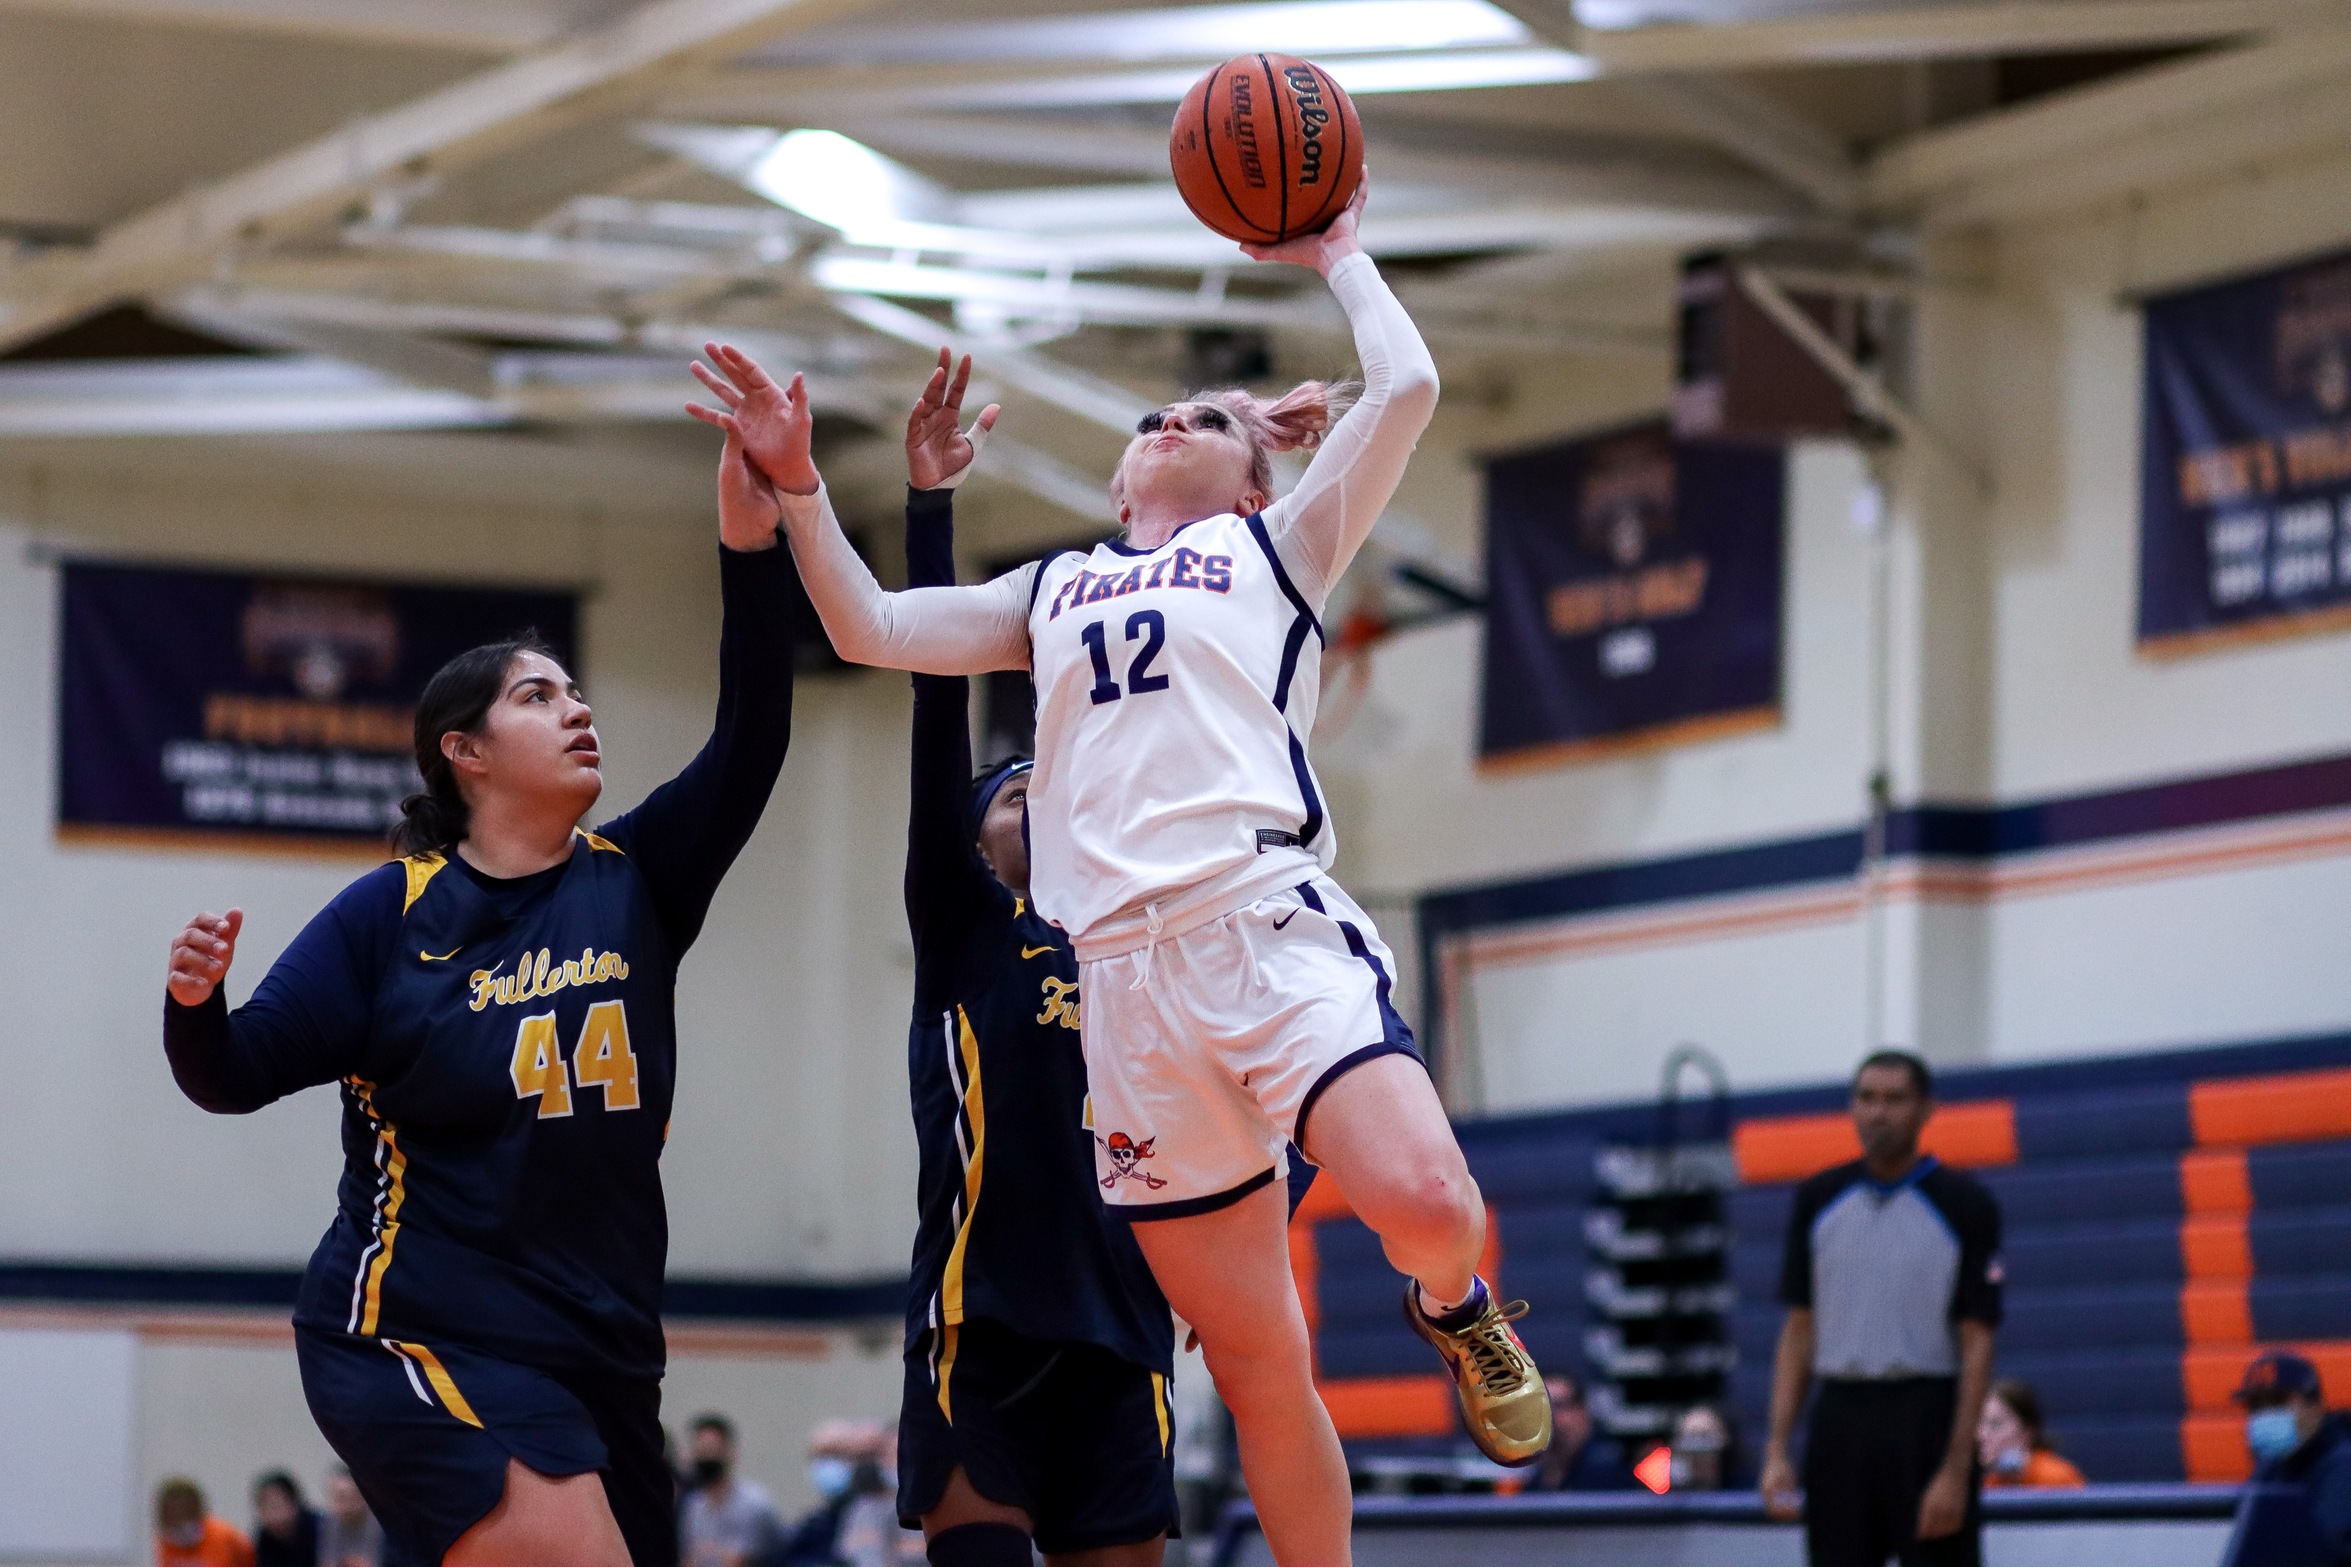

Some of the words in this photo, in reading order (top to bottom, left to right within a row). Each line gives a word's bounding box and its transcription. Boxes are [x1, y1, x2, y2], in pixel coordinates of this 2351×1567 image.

[1231, 74, 1267, 189] EVOLUTION
[1283, 65, 1330, 188] Wilson
[1049, 547, 1234, 622] PIRATES
[1081, 609, 1169, 705] 12
[469, 948, 629, 1011] Fullerton
[509, 999, 640, 1120] 44
